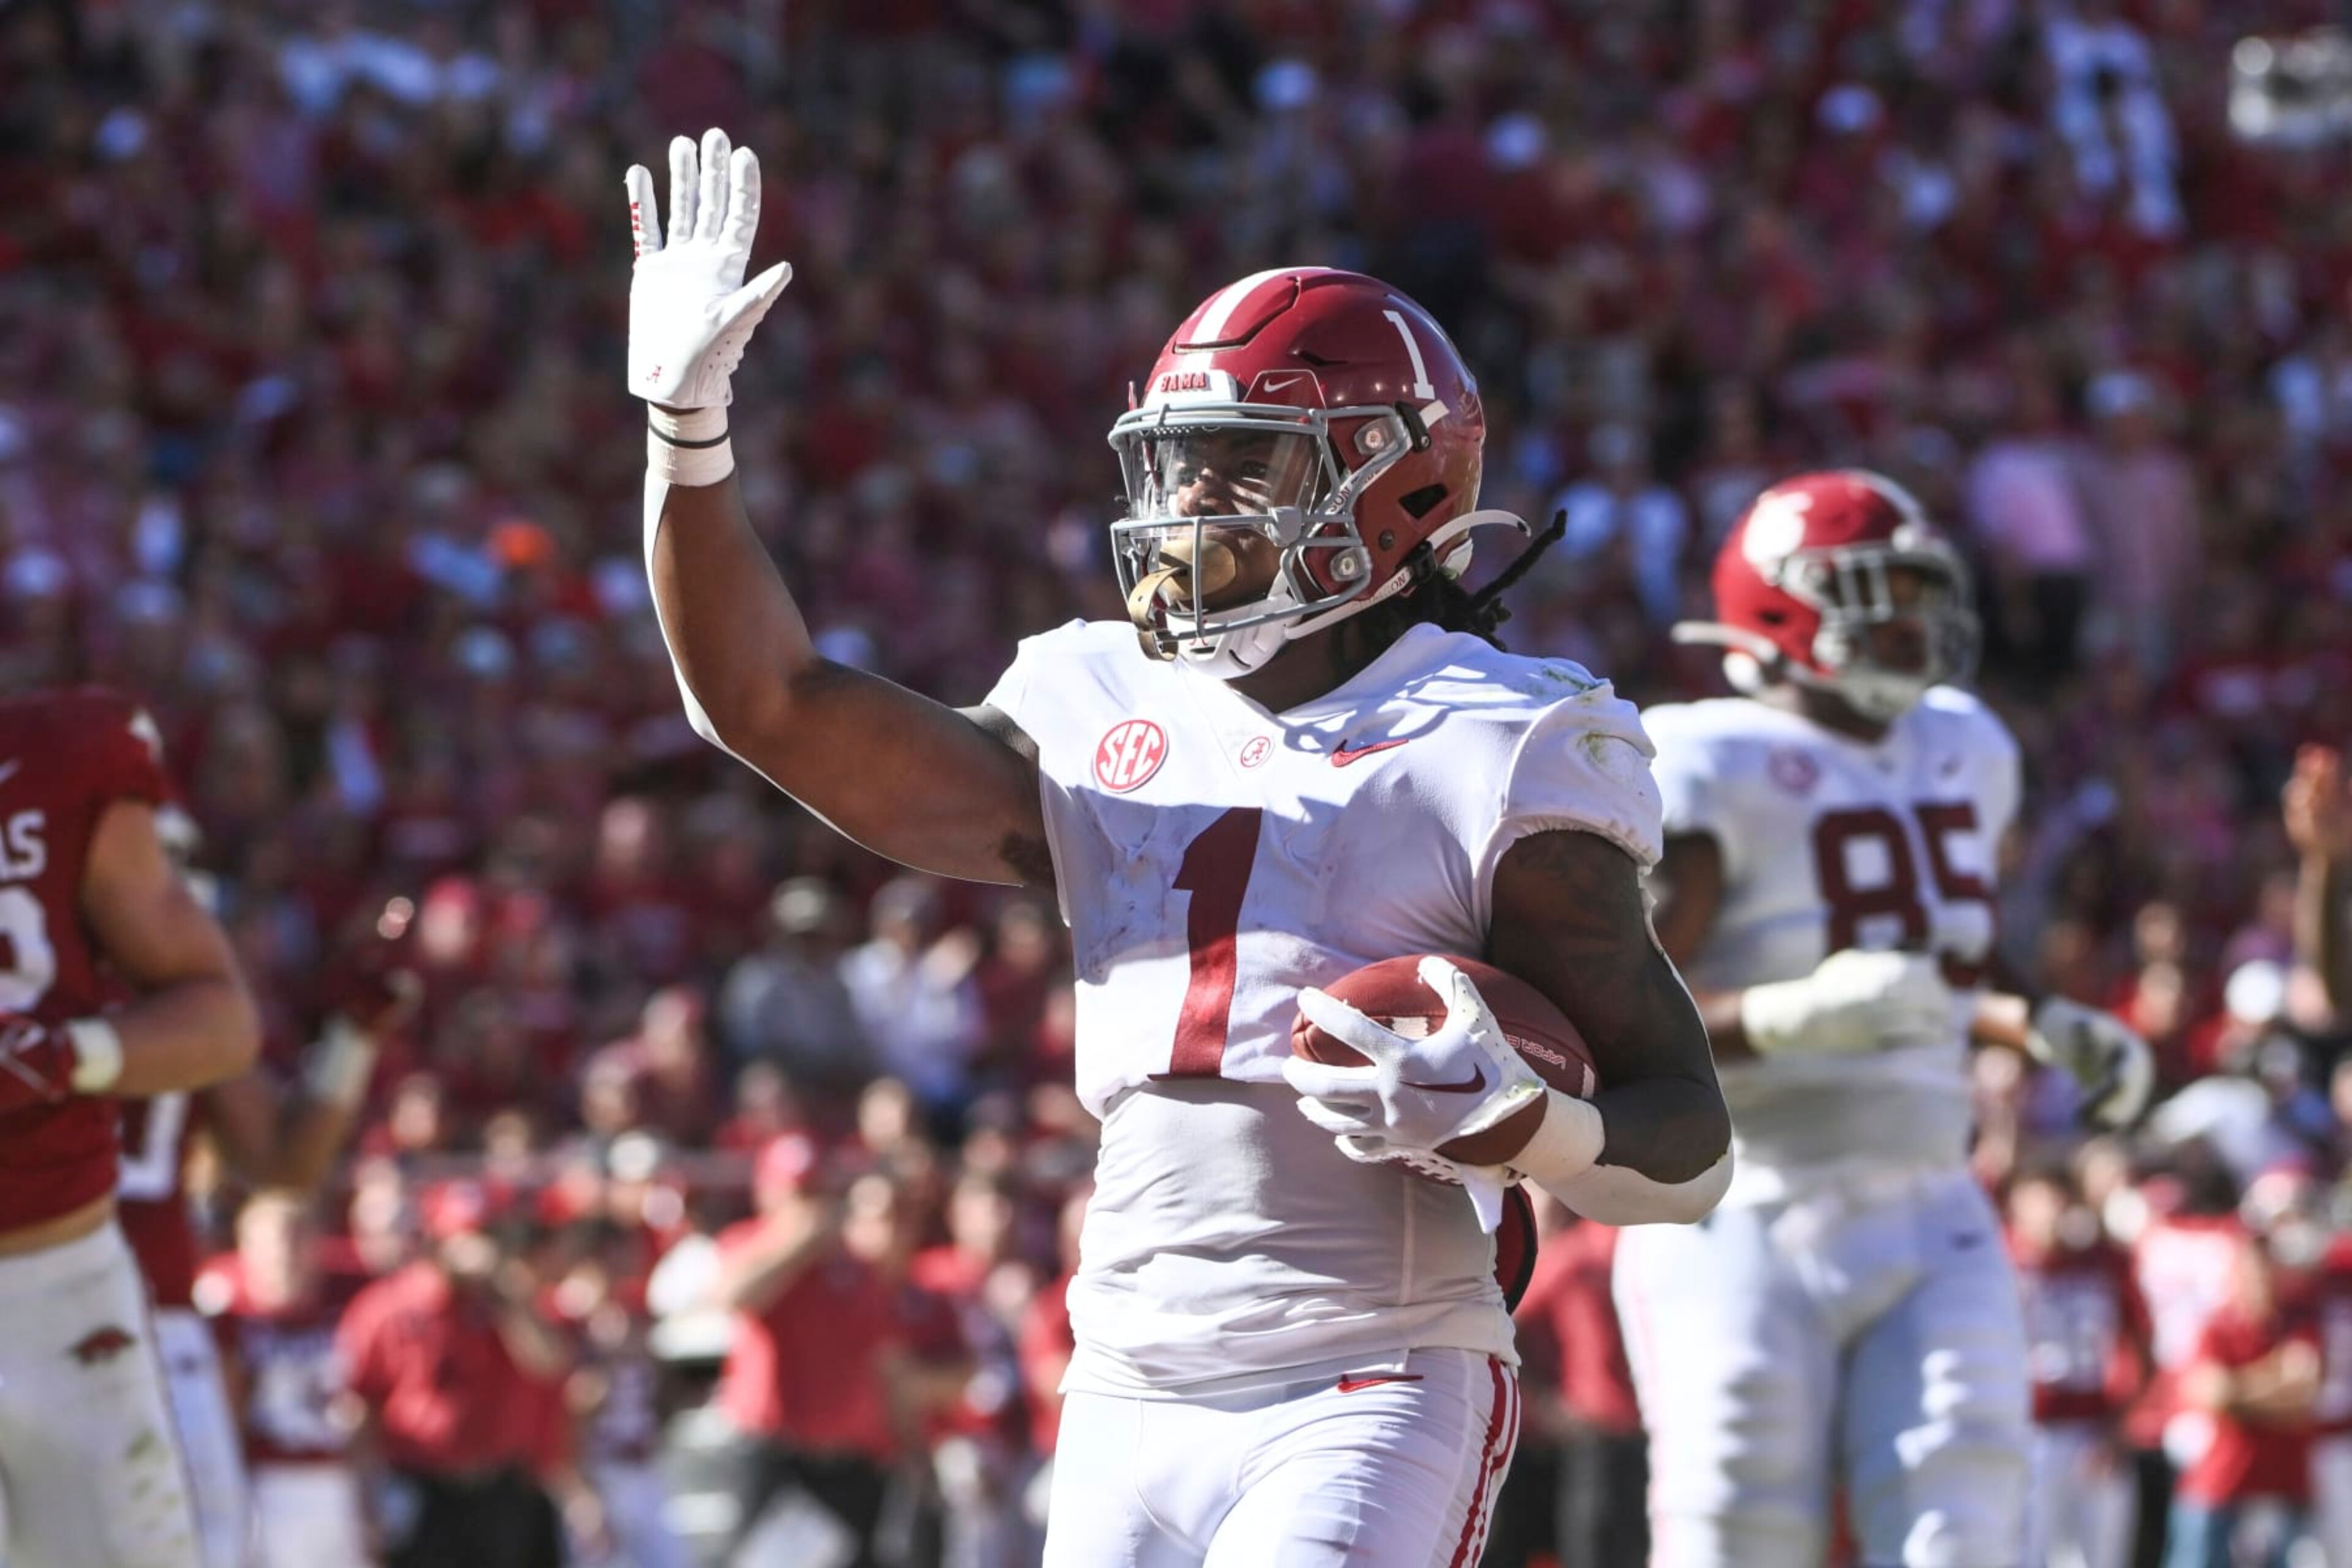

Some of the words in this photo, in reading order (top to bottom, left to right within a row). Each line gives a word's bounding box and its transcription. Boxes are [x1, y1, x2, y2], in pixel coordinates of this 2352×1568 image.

[1382, 310, 1436, 400] 1
[1099, 722, 1161, 785] SEC
[1147, 807, 1263, 1081] 1
[1812, 801, 1995, 987] 85
